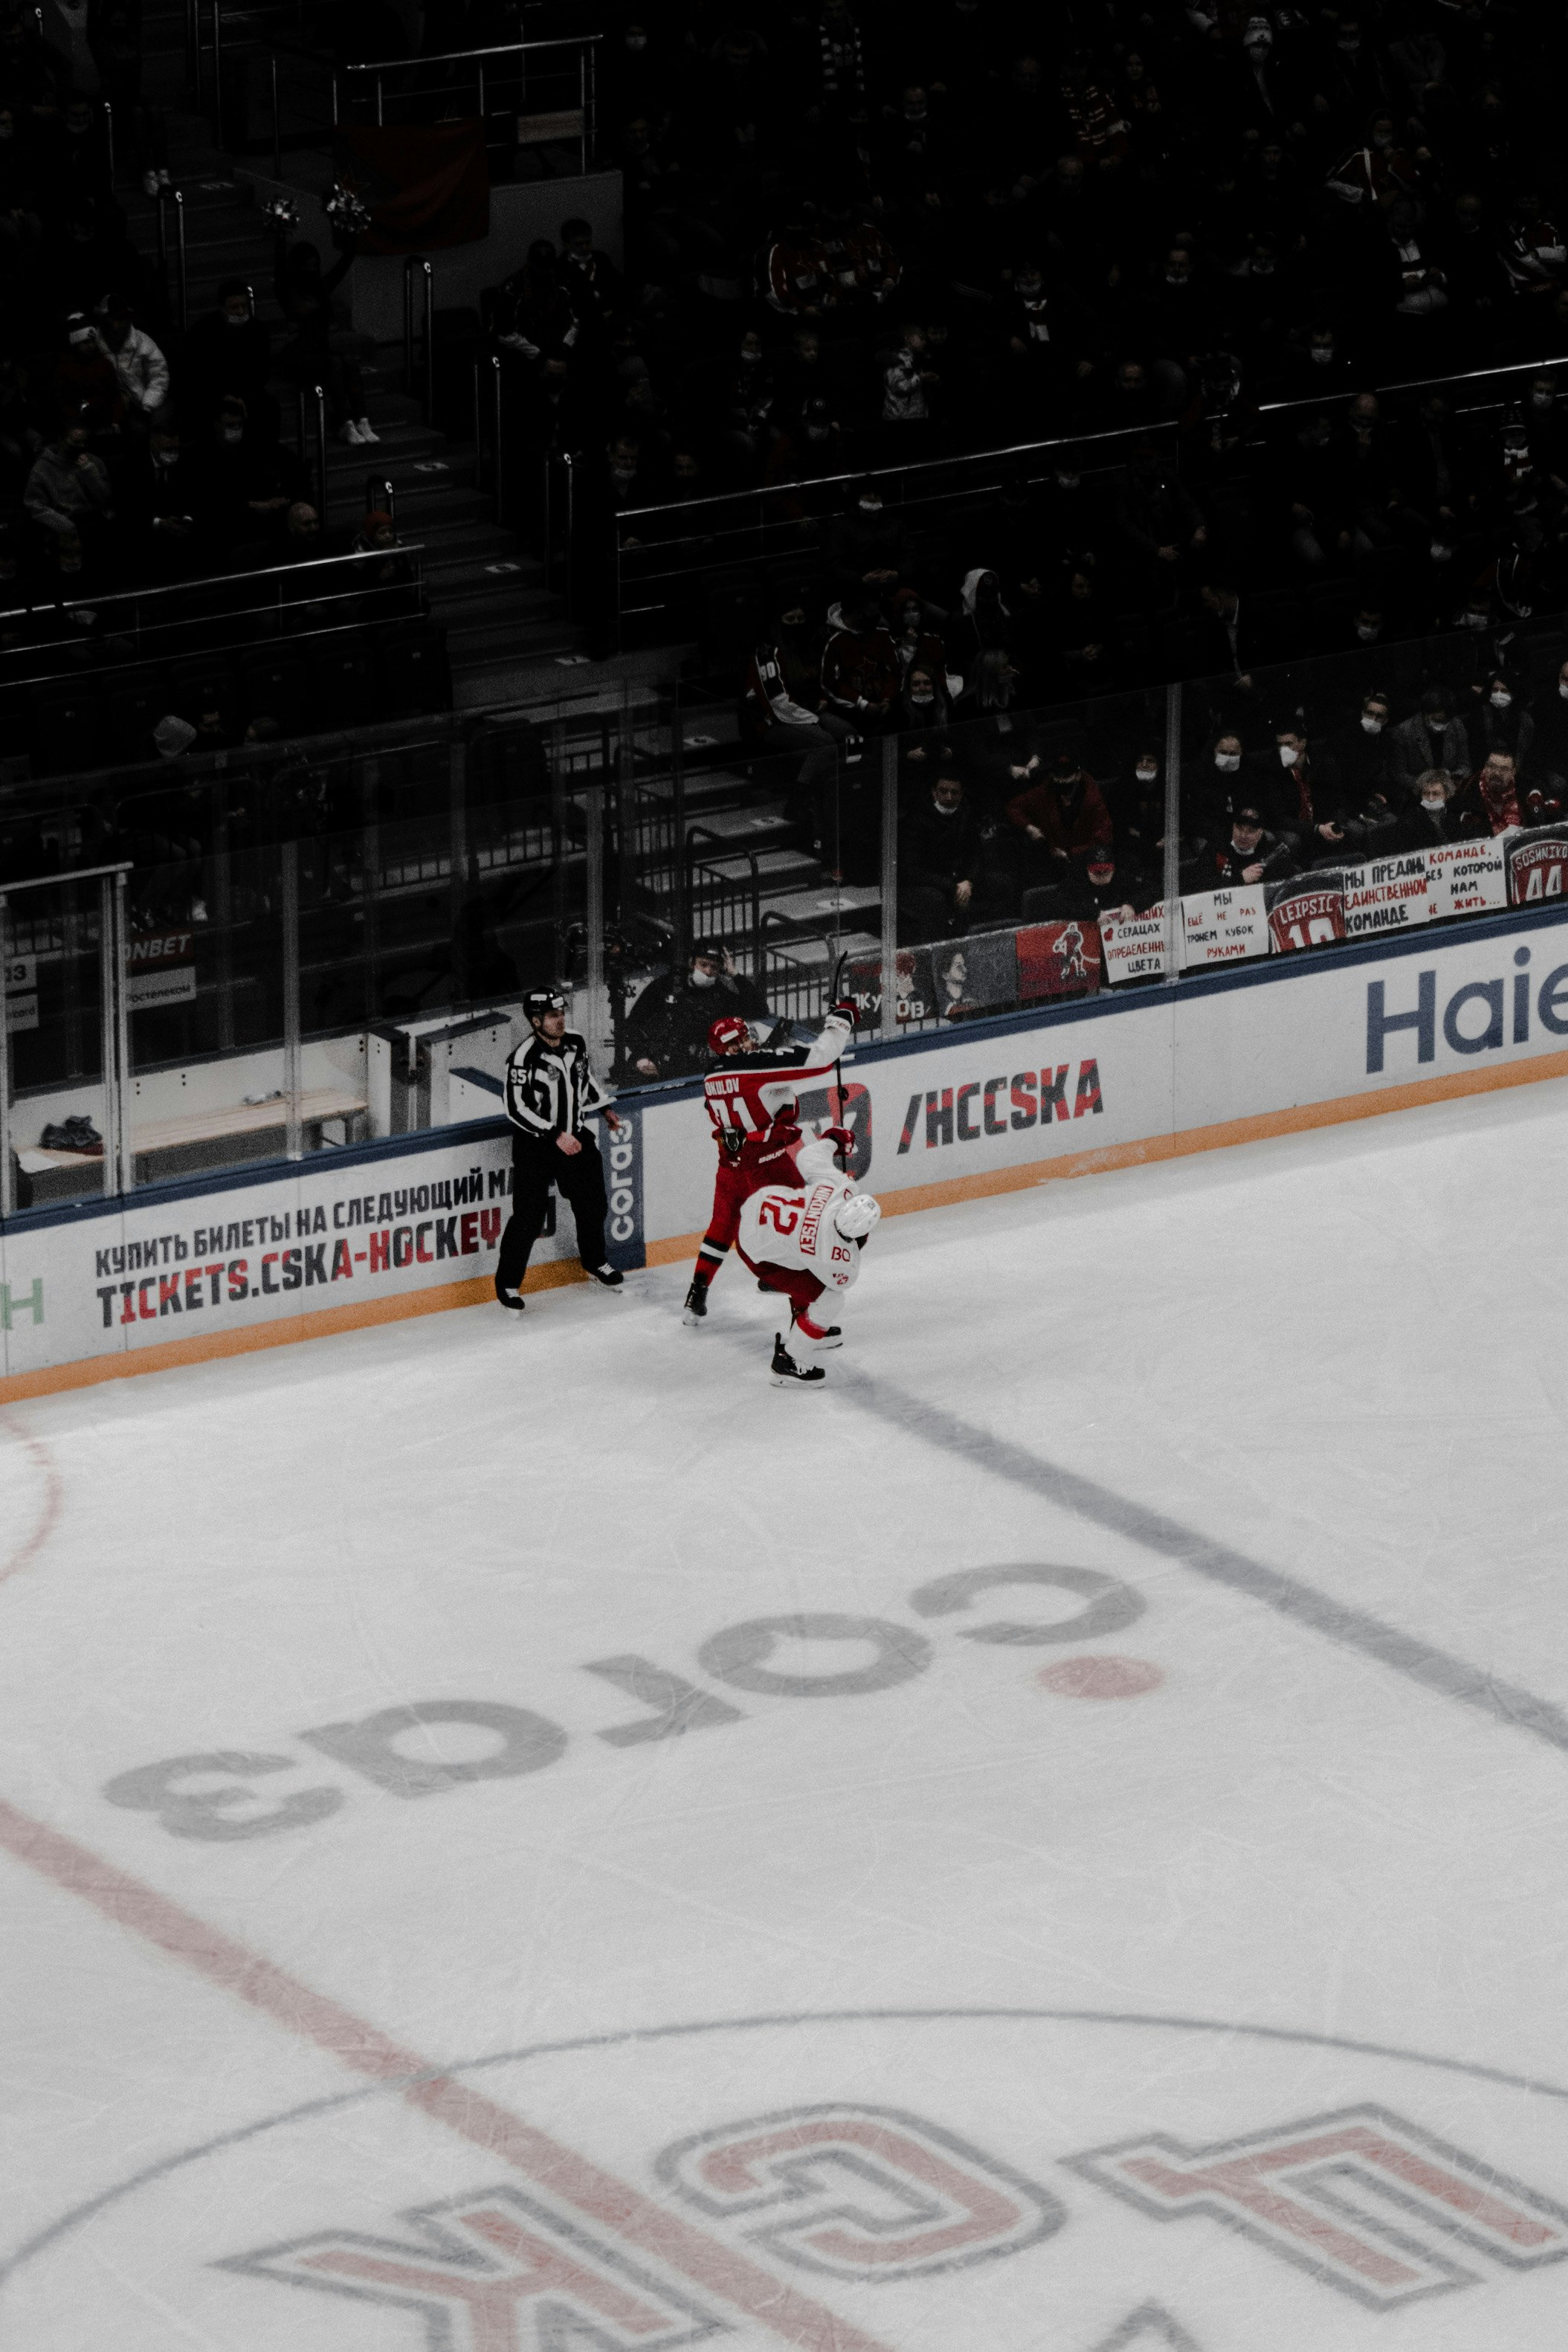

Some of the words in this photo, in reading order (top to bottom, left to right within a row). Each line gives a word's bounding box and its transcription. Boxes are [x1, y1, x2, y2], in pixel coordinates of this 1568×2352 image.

[1429, 845, 1491, 865] КОМАНДЕ,
[1344, 869, 1365, 890] МЫ
[1425, 868, 1442, 882] БЕЗ
[1454, 855, 1503, 877] КОТОРОЙ
[1451, 881, 1478, 895] НАМ
[1526, 865, 1562, 902] 44
[1213, 892, 1232, 906] МЫ
[1280, 895, 1335, 925] LEIPSIC
[1216, 911, 1227, 921] НЕ
[1239, 907, 1256, 916] РАЗ
[1345, 904, 1409, 934] КОМАНДЕ
[1117, 923, 1161, 938] СЕРДЦАХ
[1225, 925, 1254, 937] КУБОК
[1207, 944, 1245, 958] РУКАМИ
[1127, 958, 1161, 973] ЦВЕТА
[129, 985, 191, 1003] остелеком
[510, 1069, 527, 1086] 95
[709, 1097, 758, 1132] 71
[897, 1058, 1103, 1156] /HCCSKA
[95, 1234, 188, 1278] КУПИТЬ
[193, 1212, 291, 1257] БИЛЕТЫ
[297, 1205, 328, 1237] НА
[333, 1167, 485, 1230] СЛЕДУЮЩИЙ
[488, 1168, 514, 1199] МА
[759, 1194, 805, 1236] 12
[800, 1185, 834, 1256] NIKONTSEV
[97, 1196, 556, 1327] TICKETS.CSKA-HOCKEY
[100, 1562, 1148, 1843] согаз
